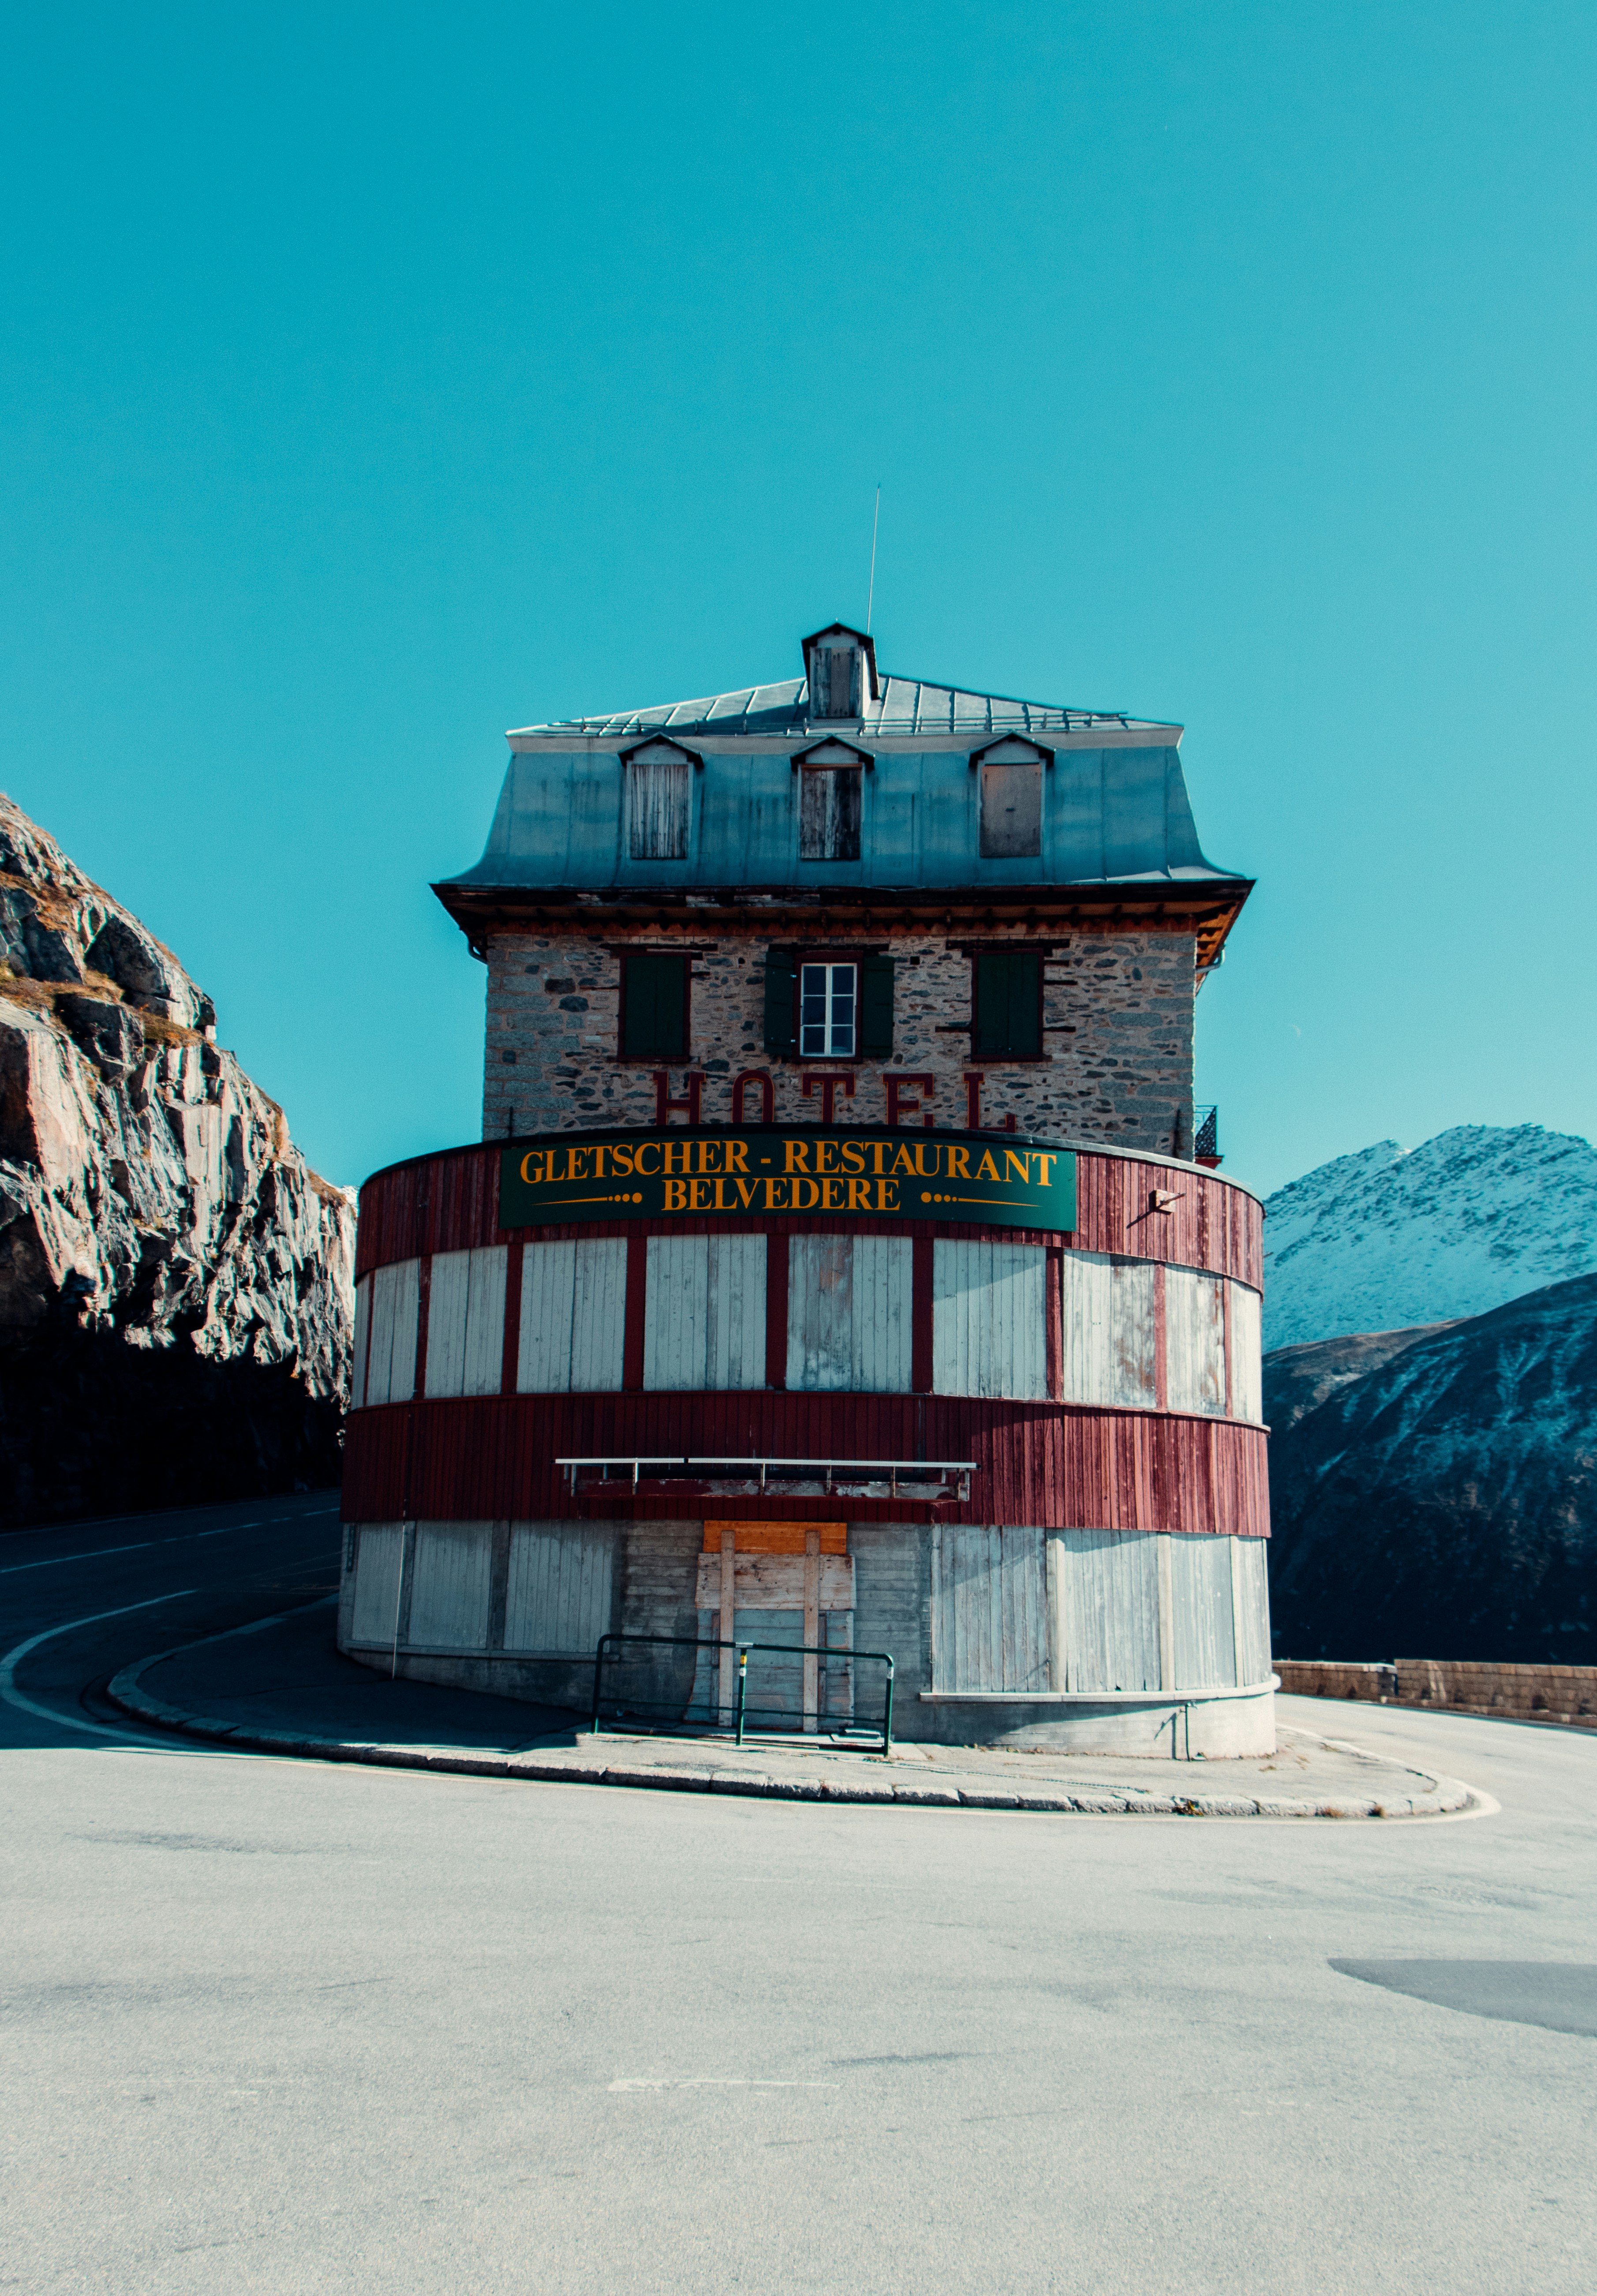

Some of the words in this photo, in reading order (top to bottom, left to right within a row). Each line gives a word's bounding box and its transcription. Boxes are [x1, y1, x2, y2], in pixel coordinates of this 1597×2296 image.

[653, 1070, 1016, 1133] HOTEL
[520, 1141, 751, 1184] GLETSCHER
[782, 1141, 1057, 1186] RESTAURANT
[661, 1178, 901, 1211] BELVEDERE
